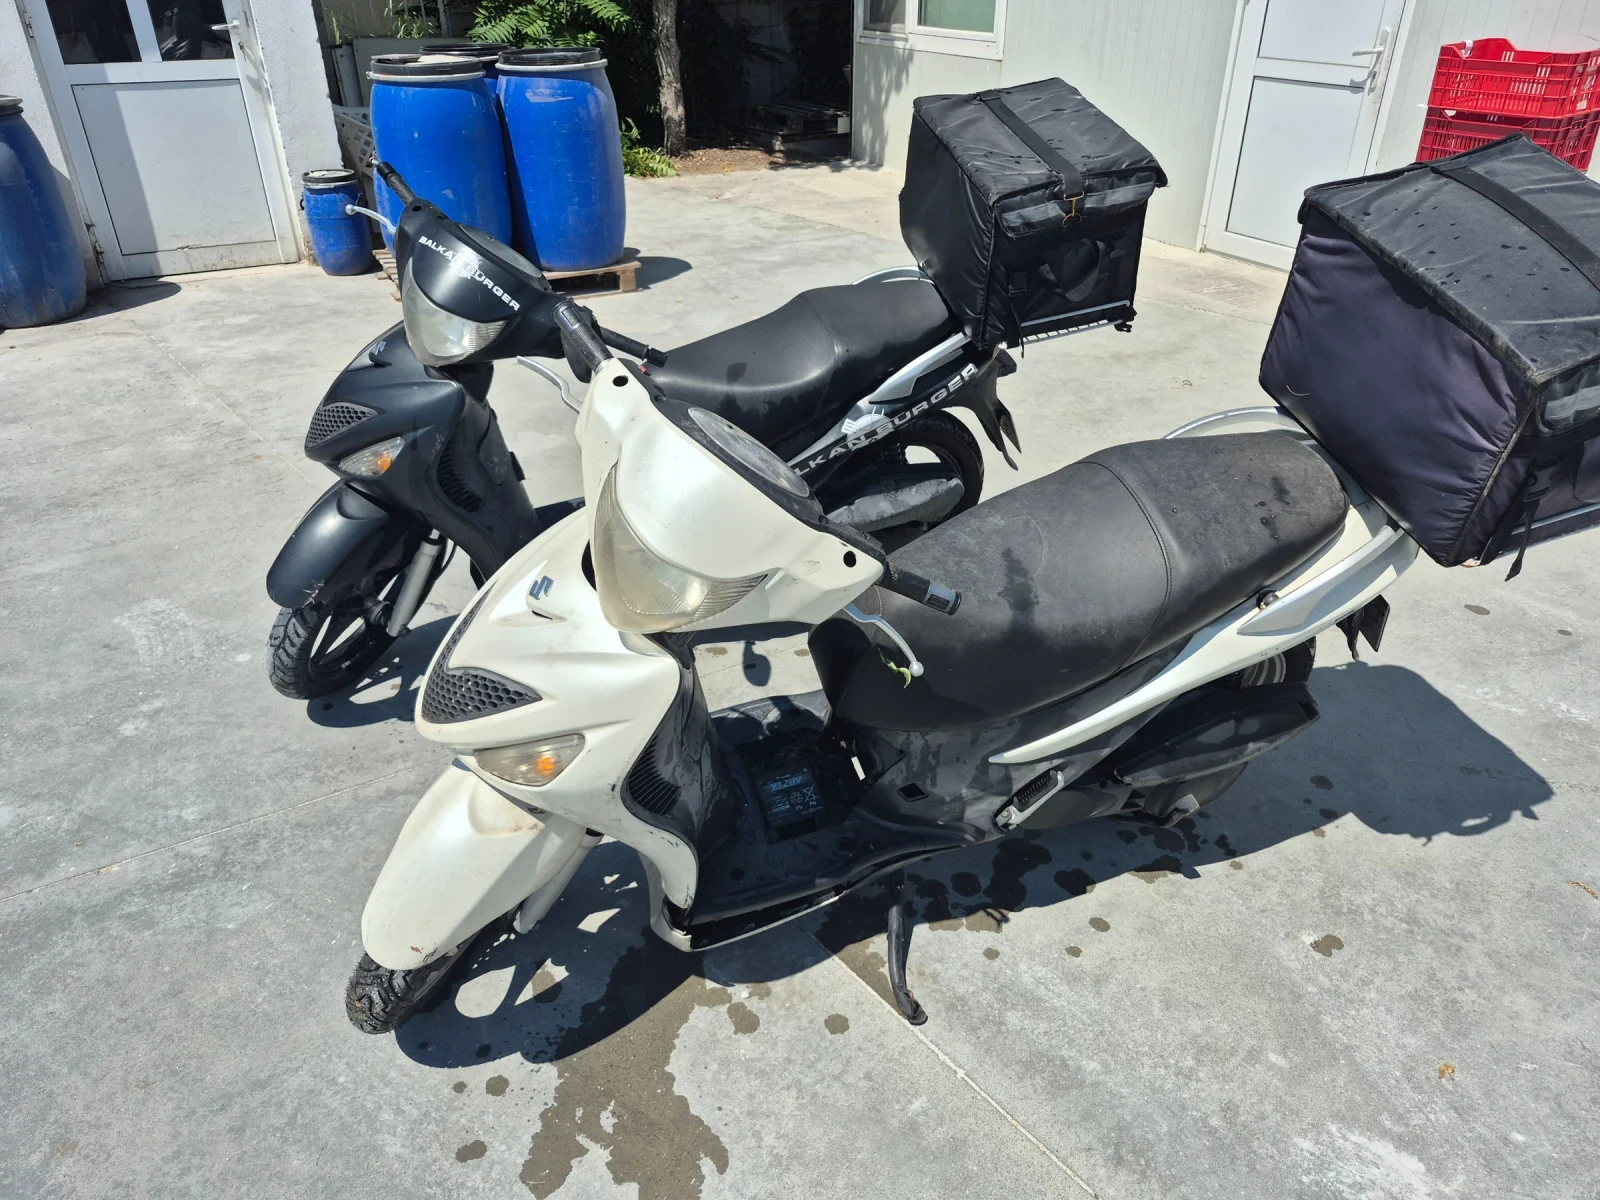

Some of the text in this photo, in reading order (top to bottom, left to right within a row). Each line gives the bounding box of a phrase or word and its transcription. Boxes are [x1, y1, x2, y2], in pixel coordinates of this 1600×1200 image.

[466, 265, 520, 311] BURGER
[795, 362, 979, 476] LKAN BURGER
